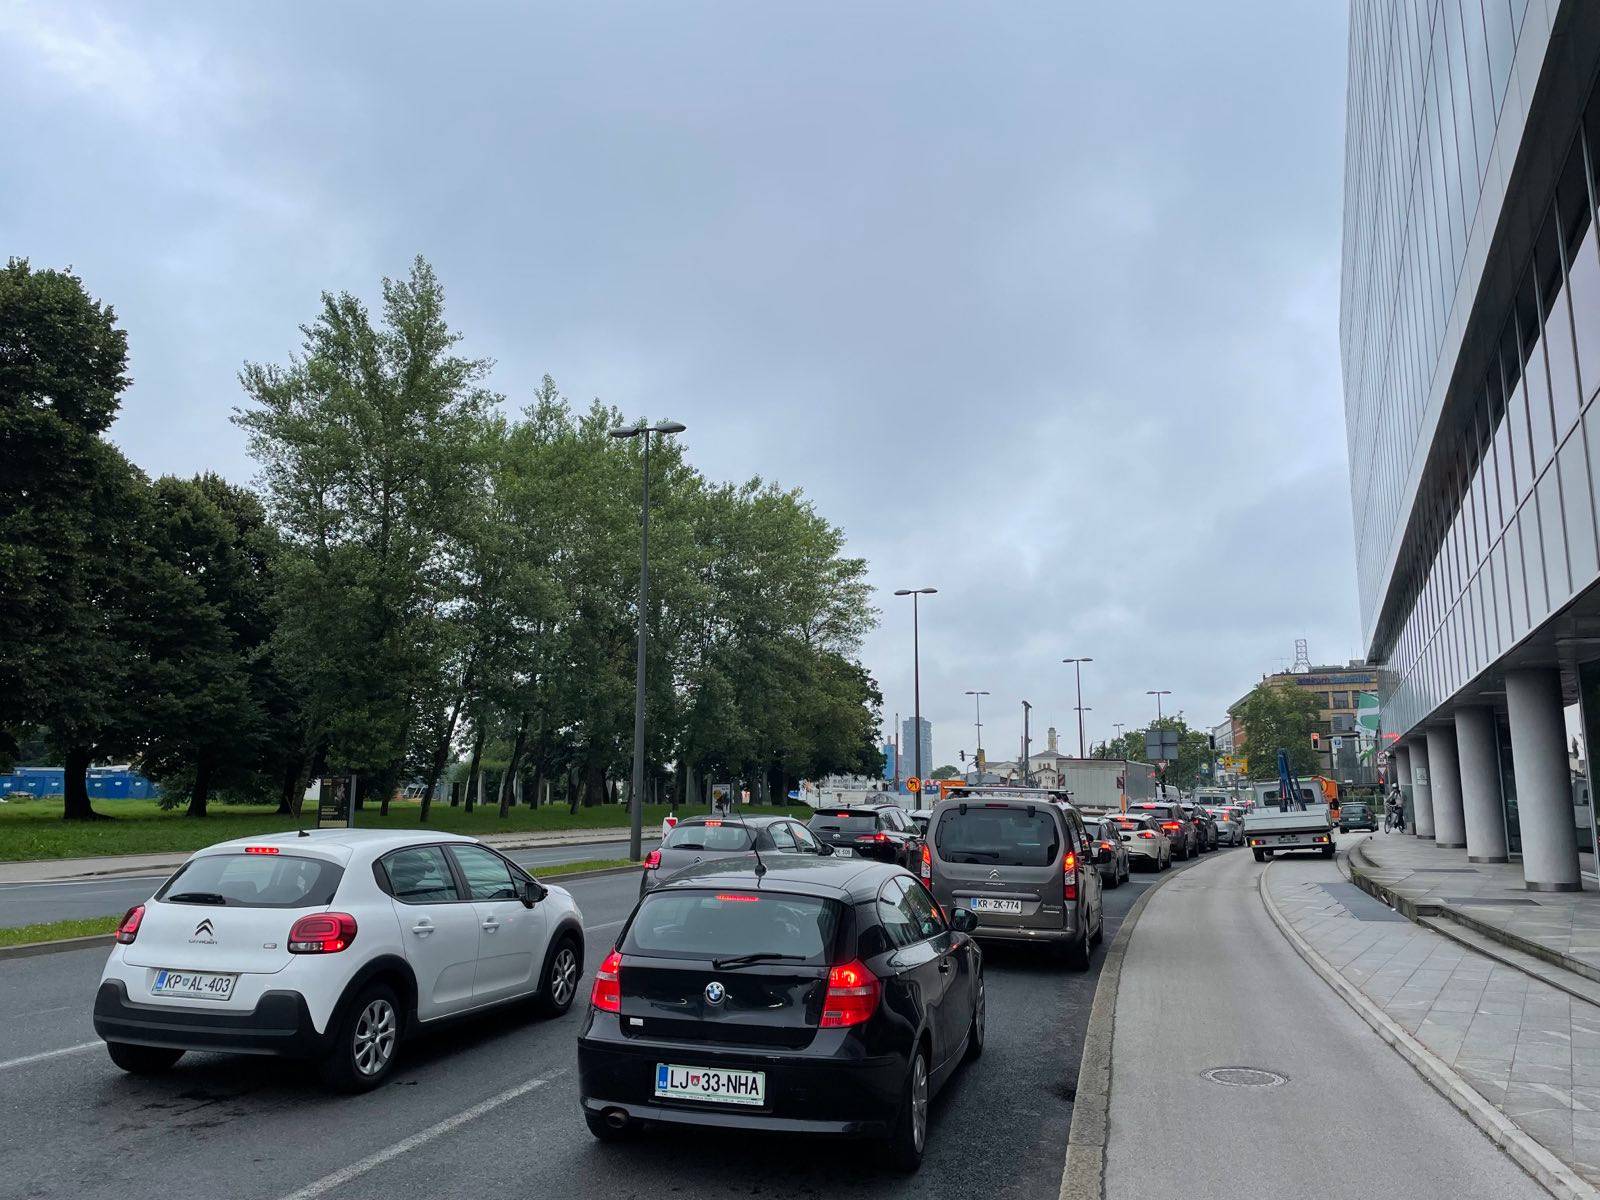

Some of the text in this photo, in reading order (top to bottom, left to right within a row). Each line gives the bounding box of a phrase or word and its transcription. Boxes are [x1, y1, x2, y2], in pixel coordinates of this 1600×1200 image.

[977, 900, 1019, 909] KR ZK-774
[165, 974, 231, 993] KP AL-403
[670, 1070, 759, 1096] LJ 33-NHA
